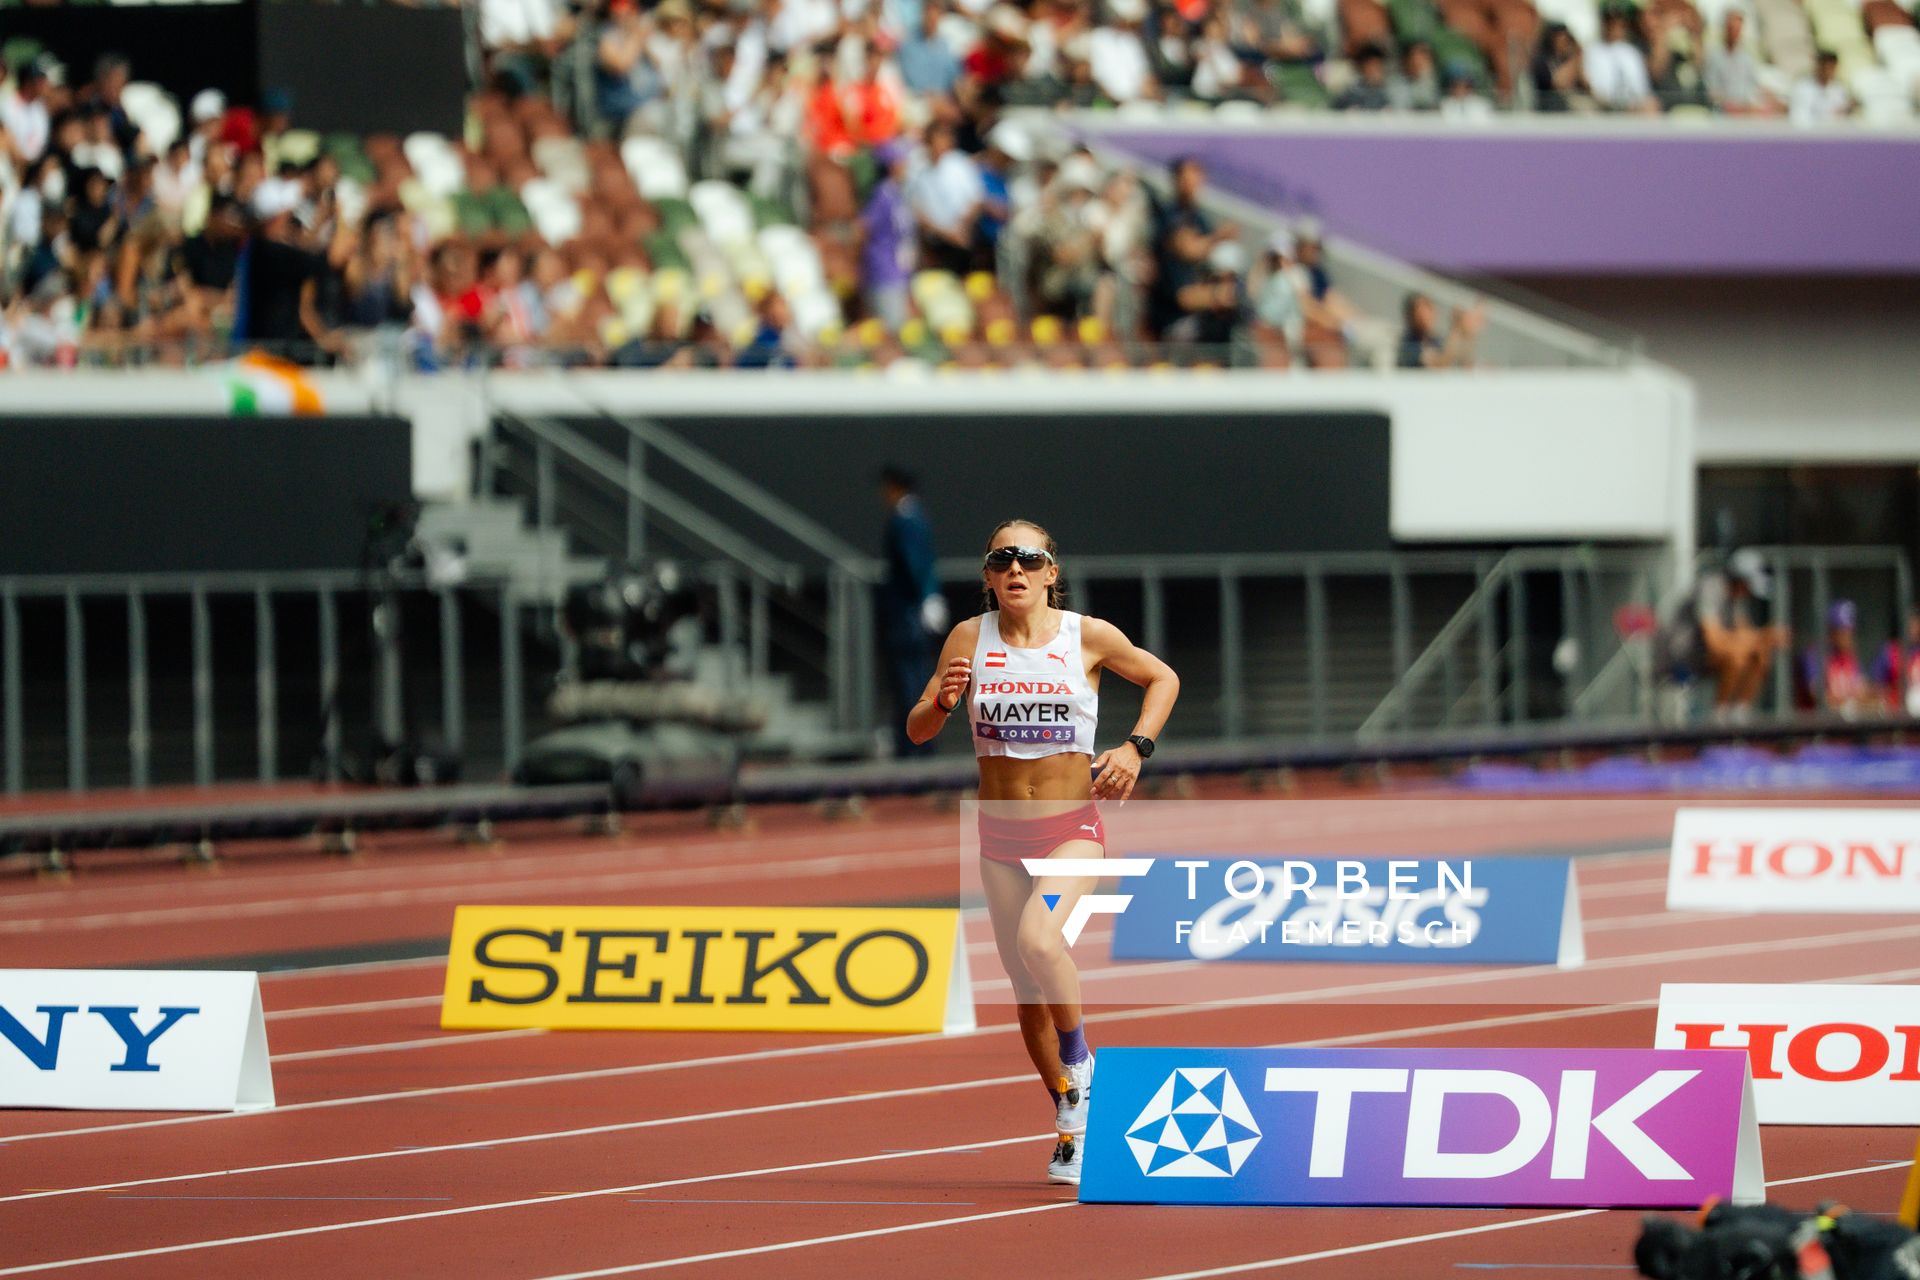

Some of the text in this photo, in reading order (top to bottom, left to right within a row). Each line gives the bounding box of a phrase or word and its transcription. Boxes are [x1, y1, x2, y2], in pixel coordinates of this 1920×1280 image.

[979, 681, 1073, 695] HONDA
[980, 702, 1070, 722] MAYER
[468, 929, 930, 1008] SEIKO
[1674, 1022, 1920, 1082] HO
[1263, 1067, 1703, 1180] TDK
